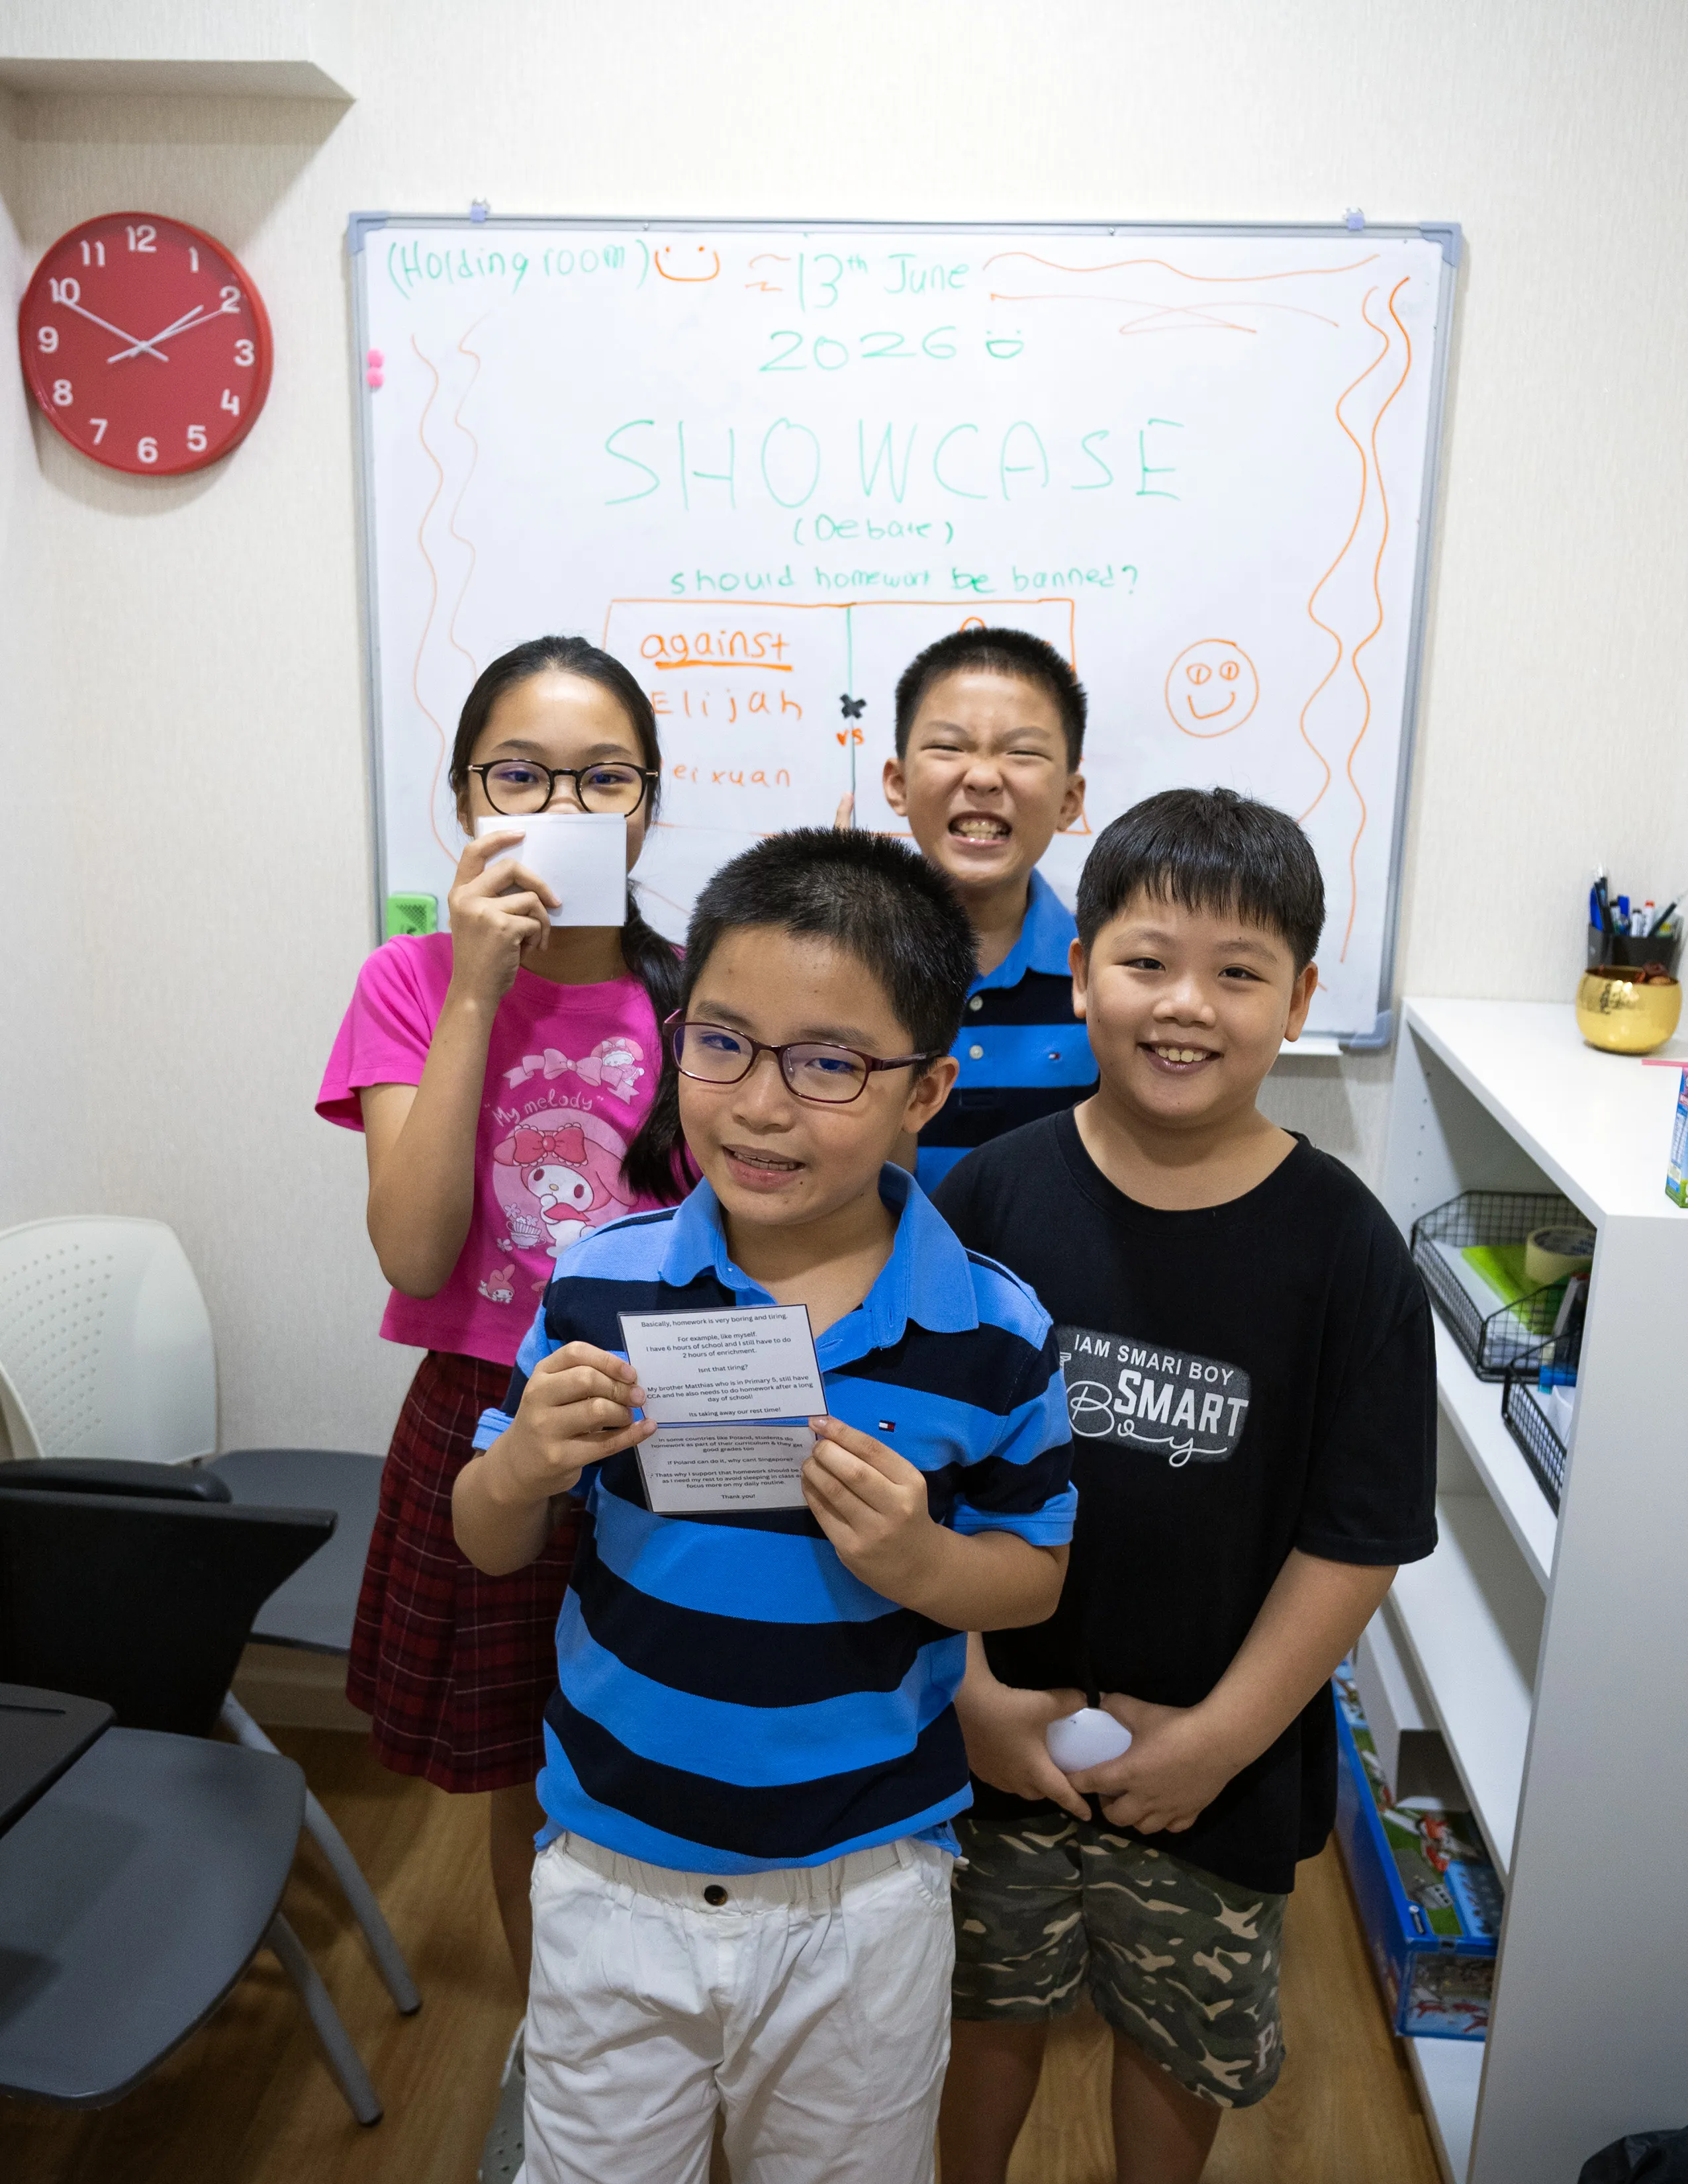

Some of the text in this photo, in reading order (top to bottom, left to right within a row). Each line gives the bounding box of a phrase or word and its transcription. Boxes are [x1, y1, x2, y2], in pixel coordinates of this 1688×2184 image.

[125, 224, 157, 253] 12
[80, 240, 105, 267] 11
[189, 246, 198, 273] 1
[882, 253, 970, 295] June
[49, 277, 80, 304] 10
[219, 286, 240, 314] 2
[38, 326, 59, 353] 9
[234, 339, 255, 367] 3
[759, 326, 956, 372] 2026
[53, 379, 73, 406] 8
[220, 388, 240, 416] 4
[90, 418, 109, 445] 7
[187, 424, 207, 452] 5
[137, 436, 158, 463] 6
[604, 418, 1184, 510] SHOWCASE
[671, 565, 794, 594] should
[952, 567, 996, 593] be
[640, 630, 789, 662] against
[651, 689, 802, 723] Elijah
[1189, 1361, 1234, 1385] BOY
[1114, 1369, 1249, 1436] SMART
